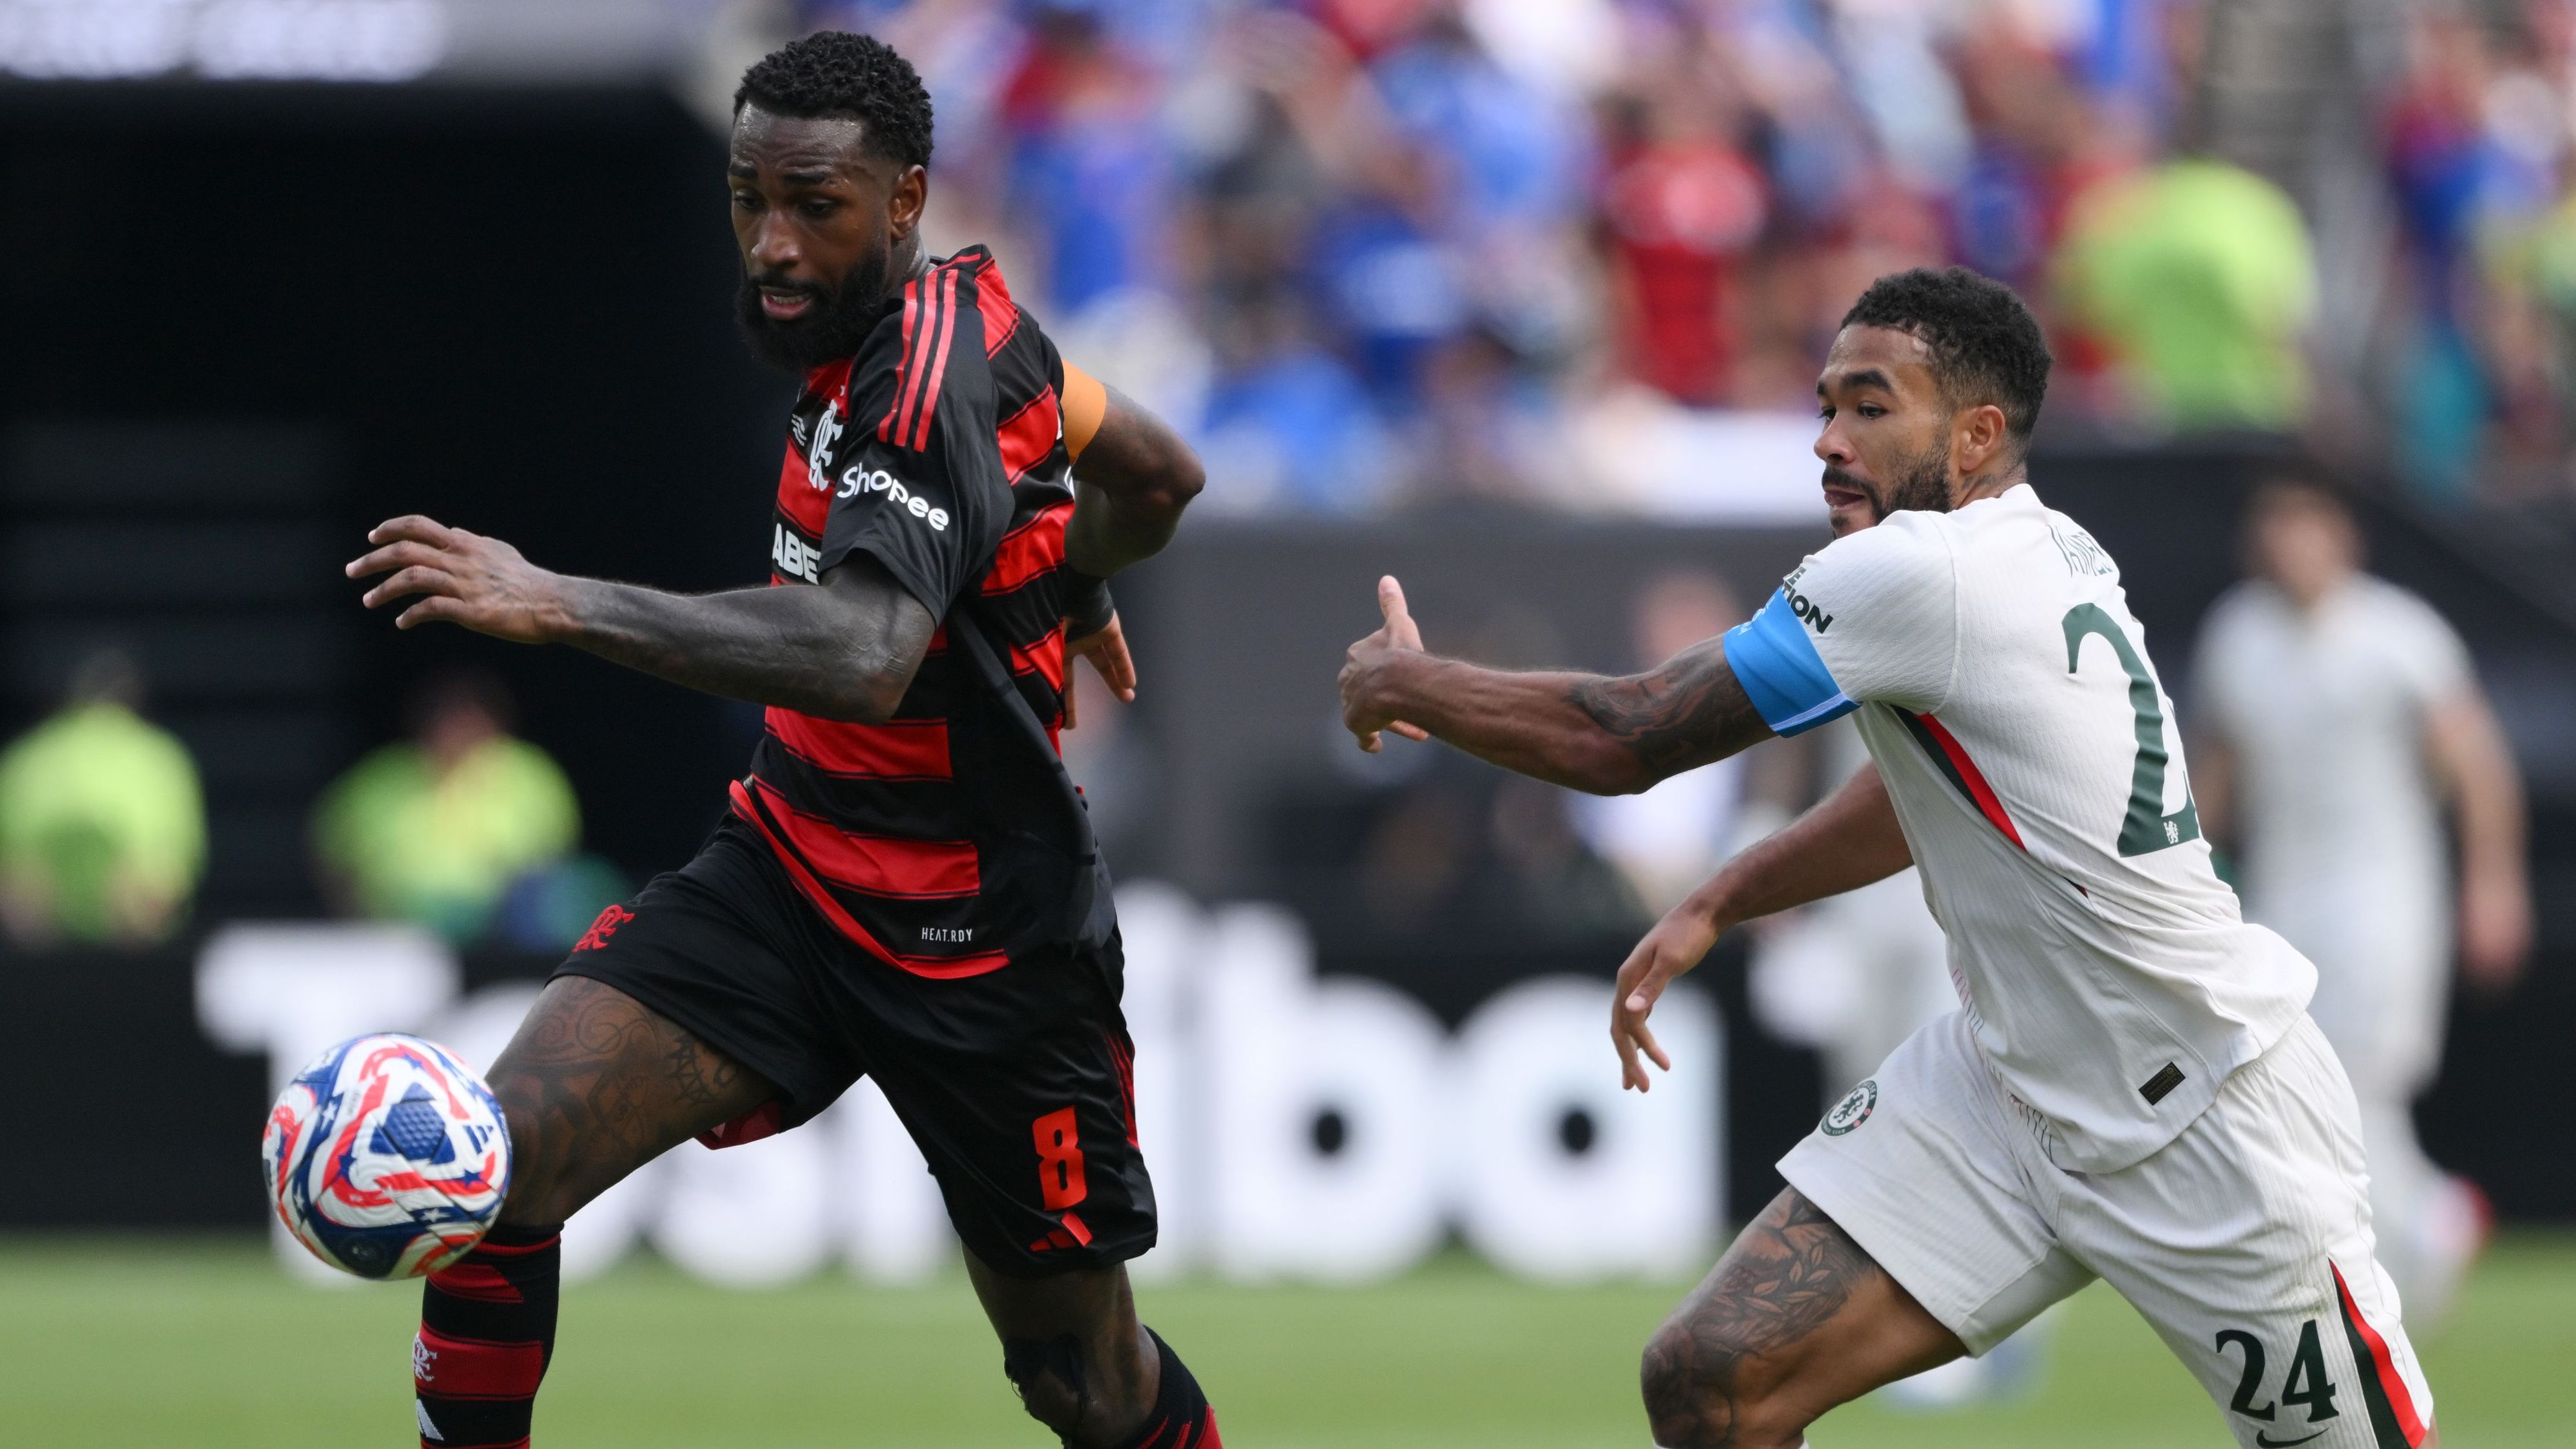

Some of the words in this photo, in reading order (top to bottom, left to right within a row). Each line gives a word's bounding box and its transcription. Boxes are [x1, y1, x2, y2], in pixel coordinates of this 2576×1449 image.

[837, 462, 949, 531] Shopee
[921, 927, 973, 942] HEAT.RDY
[1032, 1105, 1088, 1211] 8
[2215, 1319, 2340, 1423] 24
